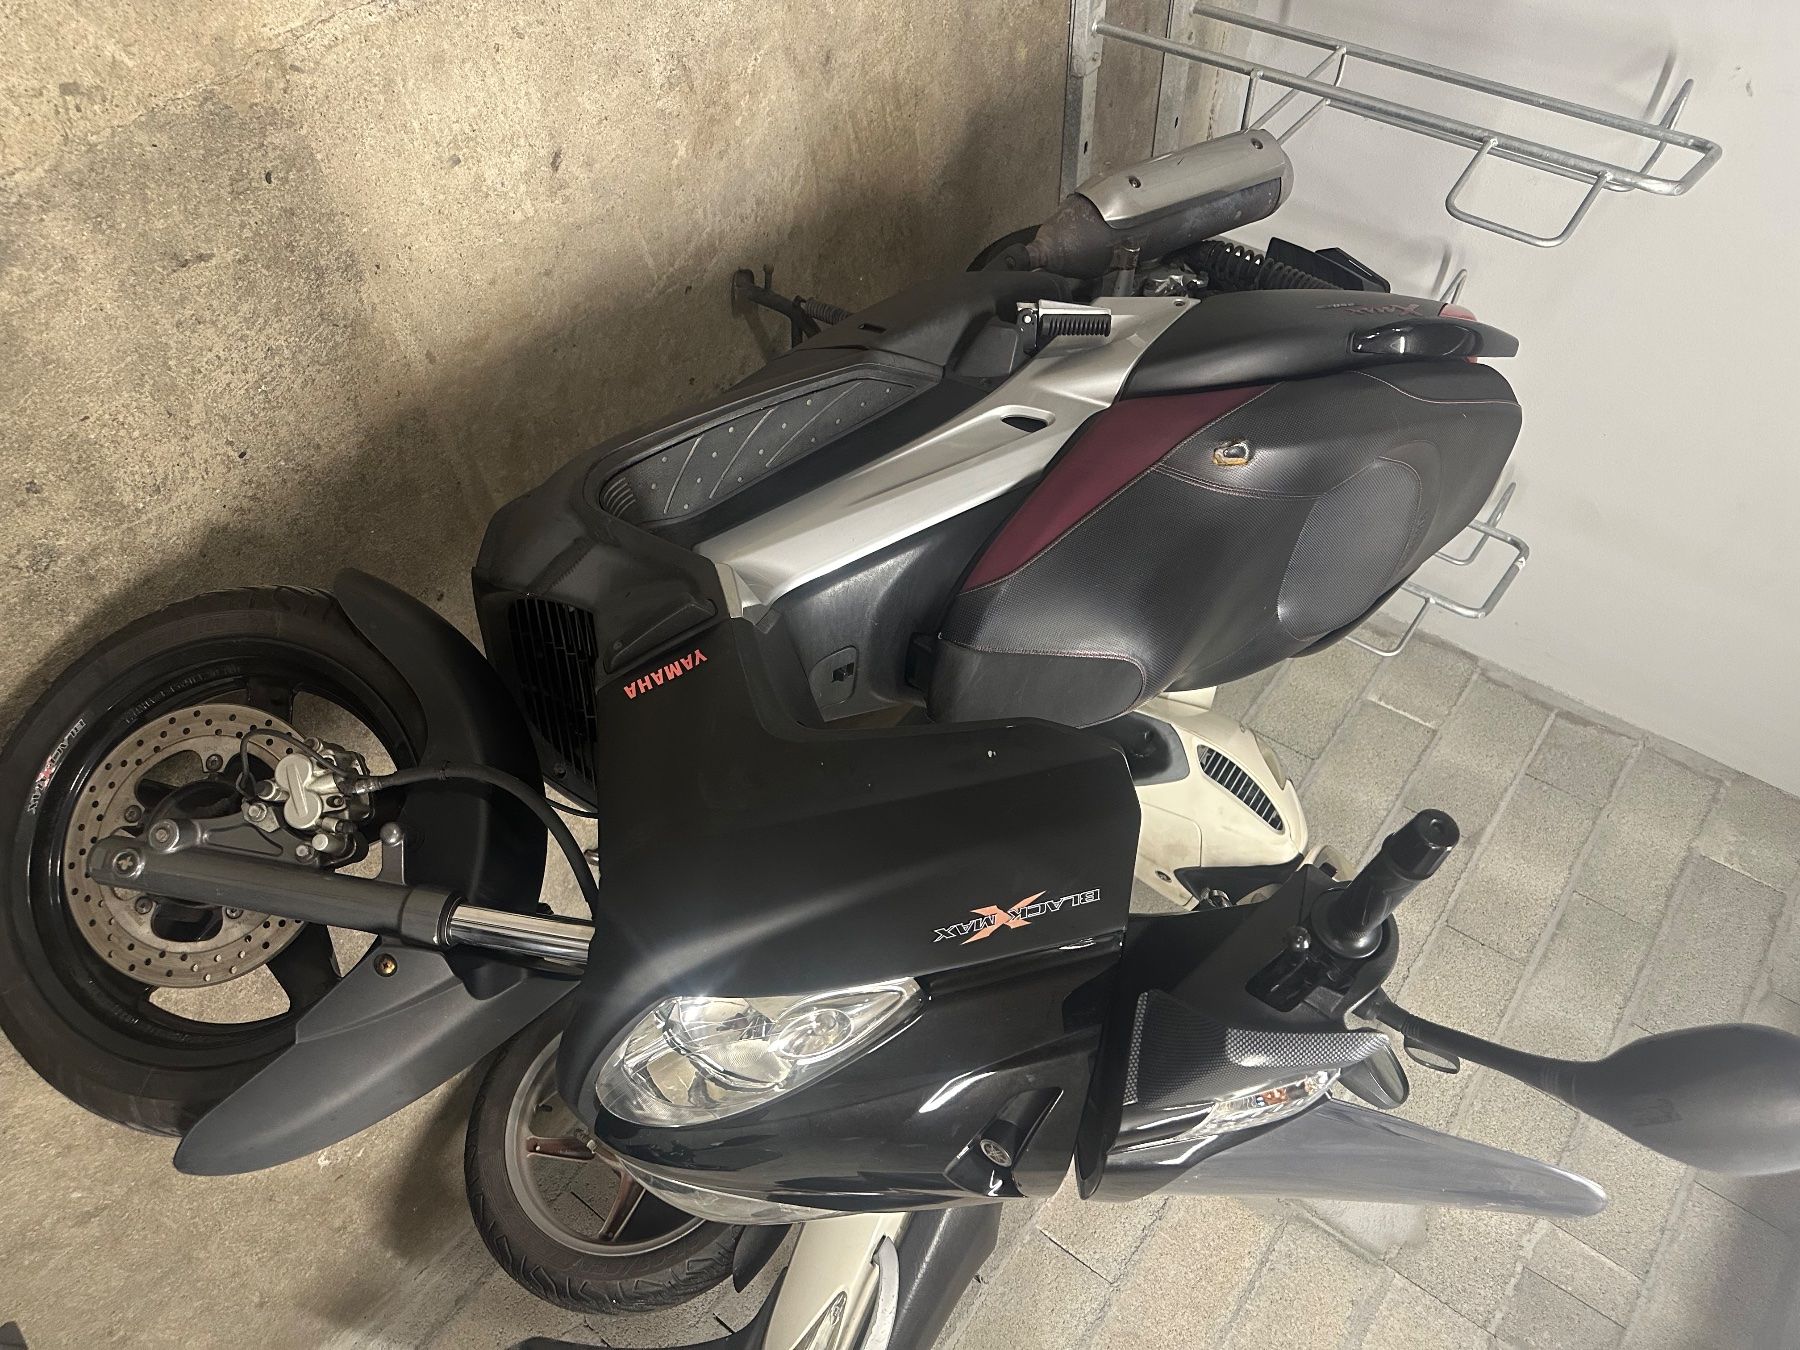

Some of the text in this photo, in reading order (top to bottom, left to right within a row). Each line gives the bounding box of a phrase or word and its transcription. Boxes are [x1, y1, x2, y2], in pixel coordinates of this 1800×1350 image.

[623, 649, 708, 700] YAMAHA
[1008, 889, 1101, 921] BLACK
[933, 914, 998, 943] MAX
